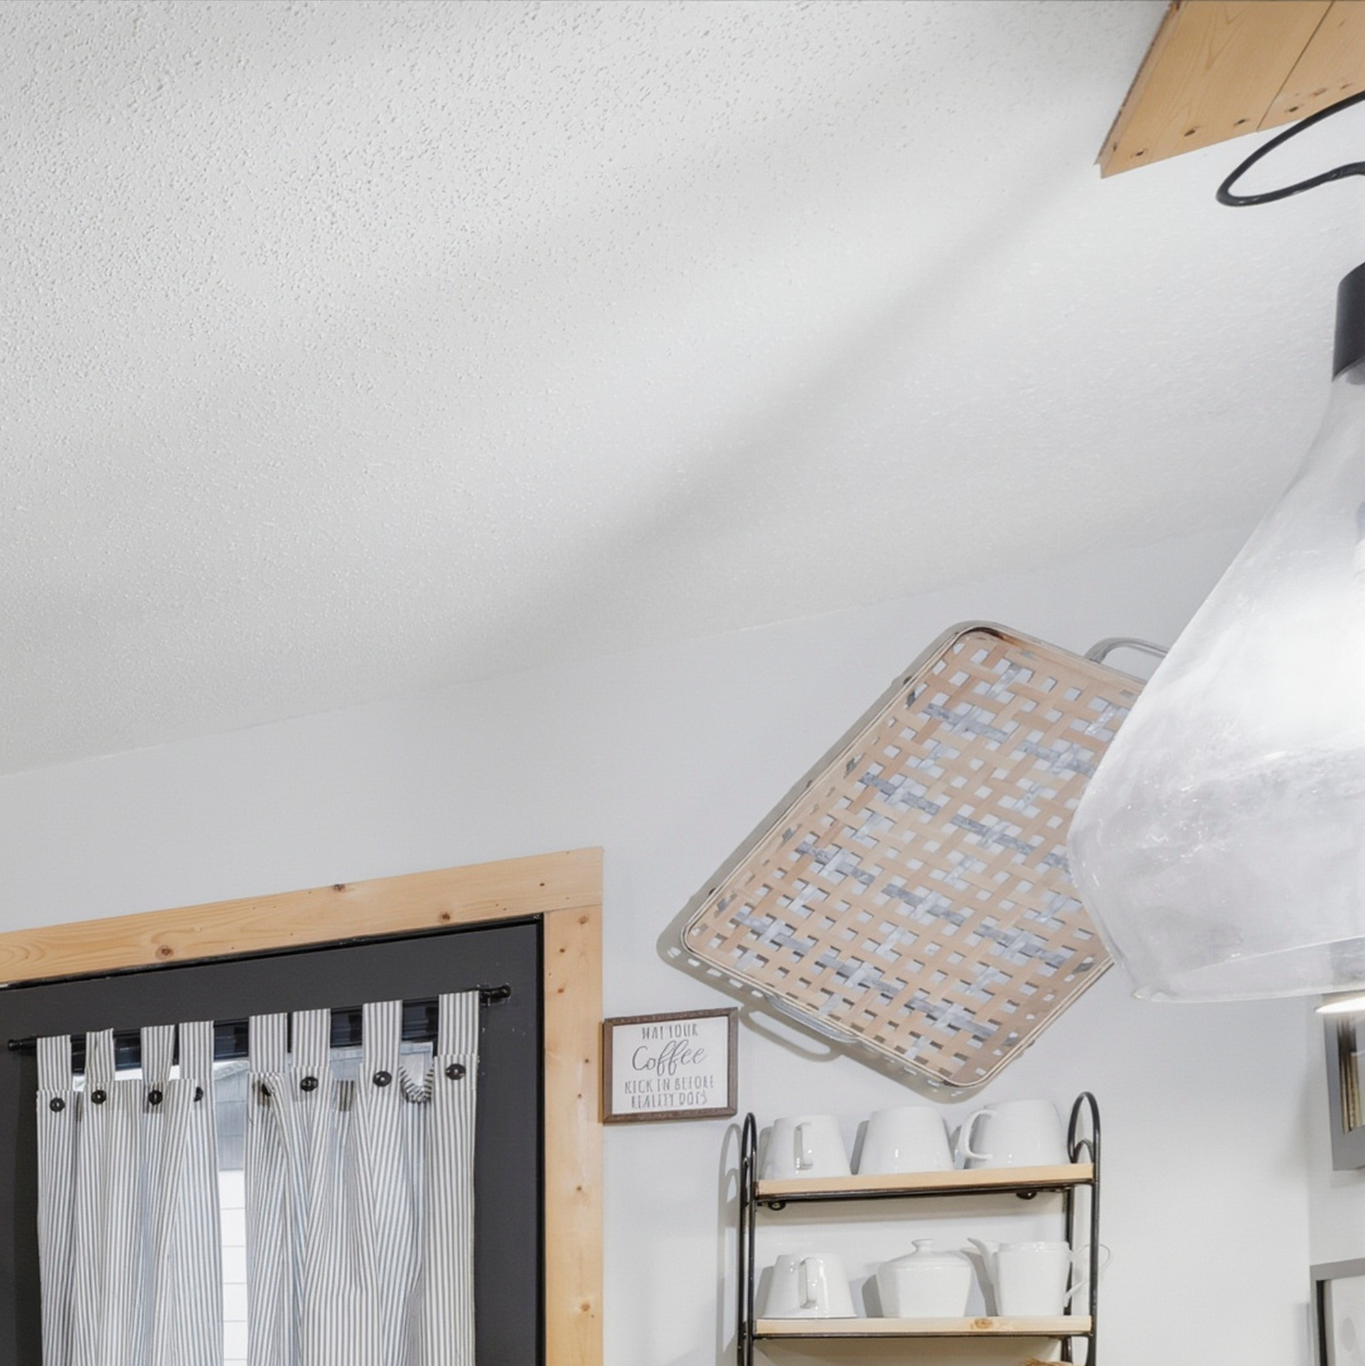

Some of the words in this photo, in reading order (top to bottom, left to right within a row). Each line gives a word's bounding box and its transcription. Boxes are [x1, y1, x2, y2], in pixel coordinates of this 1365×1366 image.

[642, 1026, 663, 1040] MAY
[670, 1023, 698, 1038] YOUR
[632, 1039, 707, 1077] Coffee
[625, 1079, 655, 1094] KICK
[657, 1078, 670, 1092] IN
[674, 1075, 714, 1091] BEFORE
[631, 1093, 674, 1109] REALITY
[679, 1091, 708, 1106] DOES
